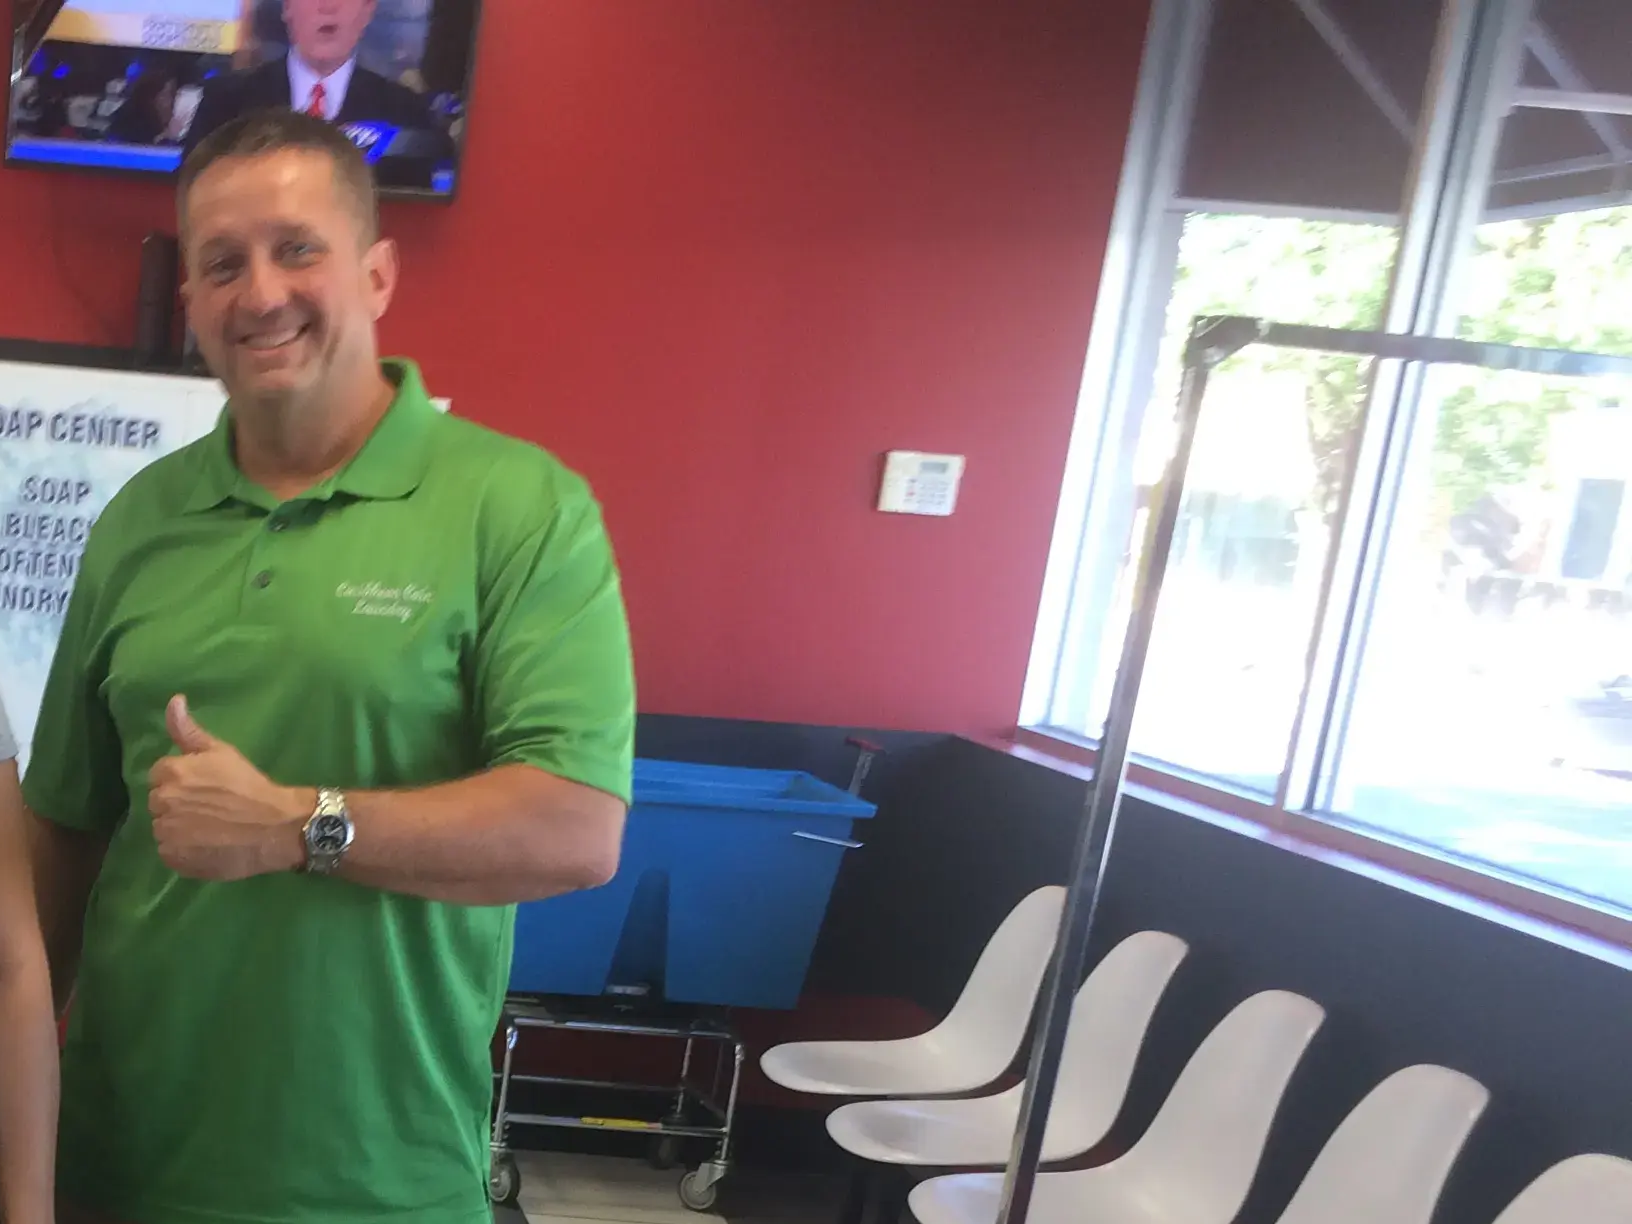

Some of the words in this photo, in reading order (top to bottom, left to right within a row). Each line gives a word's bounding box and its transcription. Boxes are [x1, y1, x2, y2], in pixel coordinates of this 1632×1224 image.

[49, 412, 161, 449] CENTER
[19, 475, 92, 507] SOAP
[1, 512, 92, 545] BLEAC
